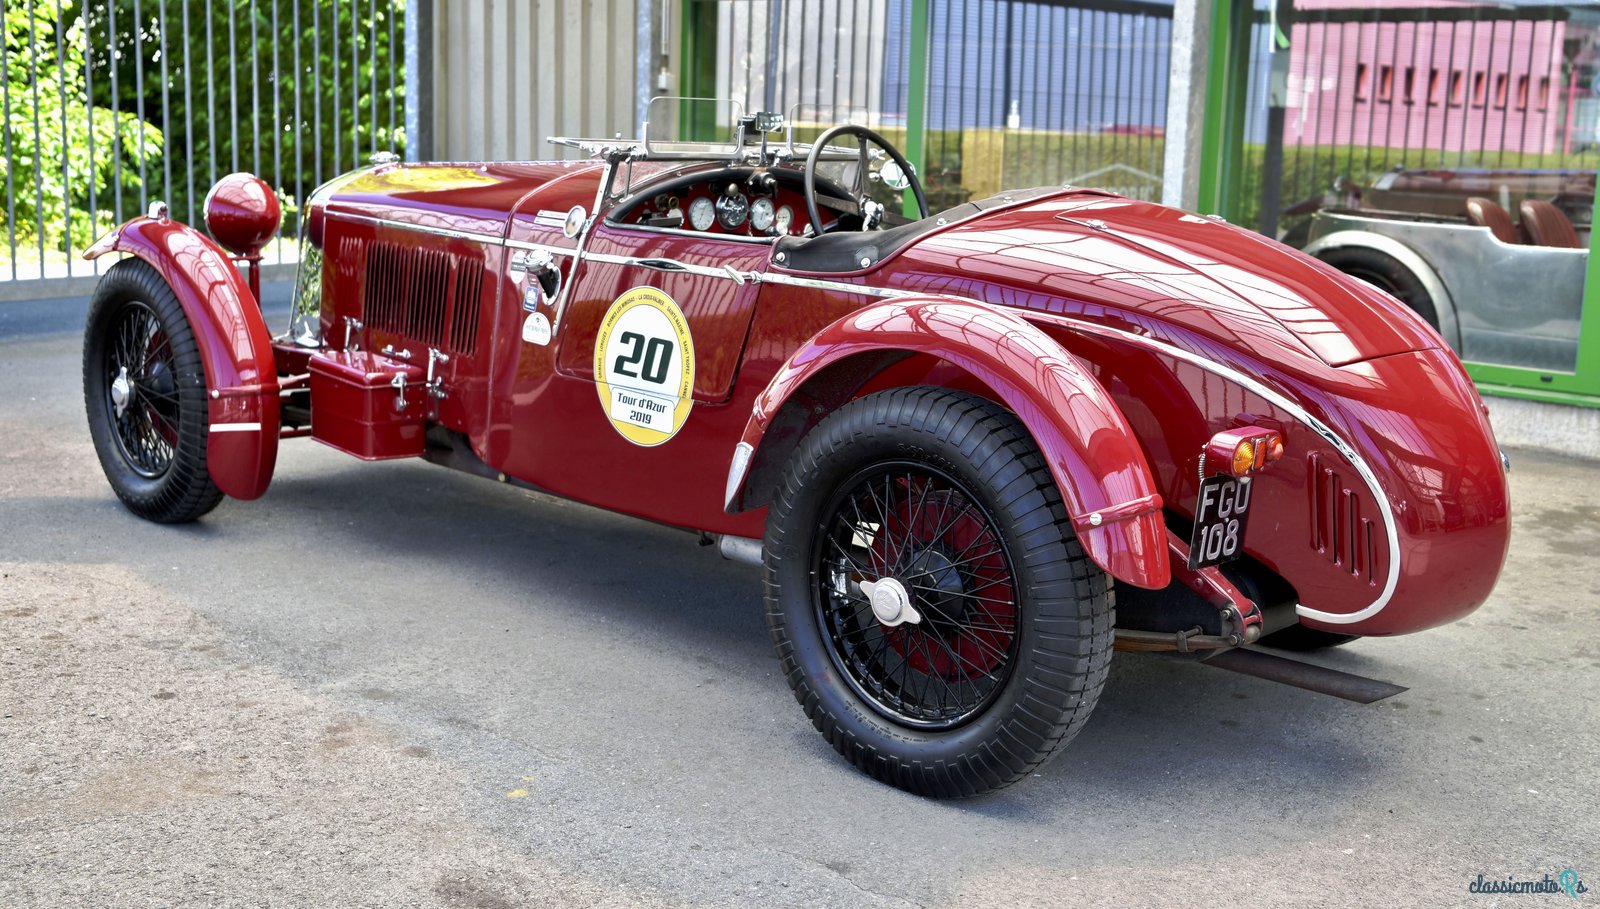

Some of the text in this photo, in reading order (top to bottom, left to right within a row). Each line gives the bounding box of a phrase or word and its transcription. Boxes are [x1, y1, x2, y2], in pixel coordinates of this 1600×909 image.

[613, 331, 674, 384] 20
[617, 392, 667, 413] Tour d'Azur
[629, 410, 652, 424] 2019
[1199, 479, 1252, 522] FGU
[1198, 519, 1240, 563] 108
